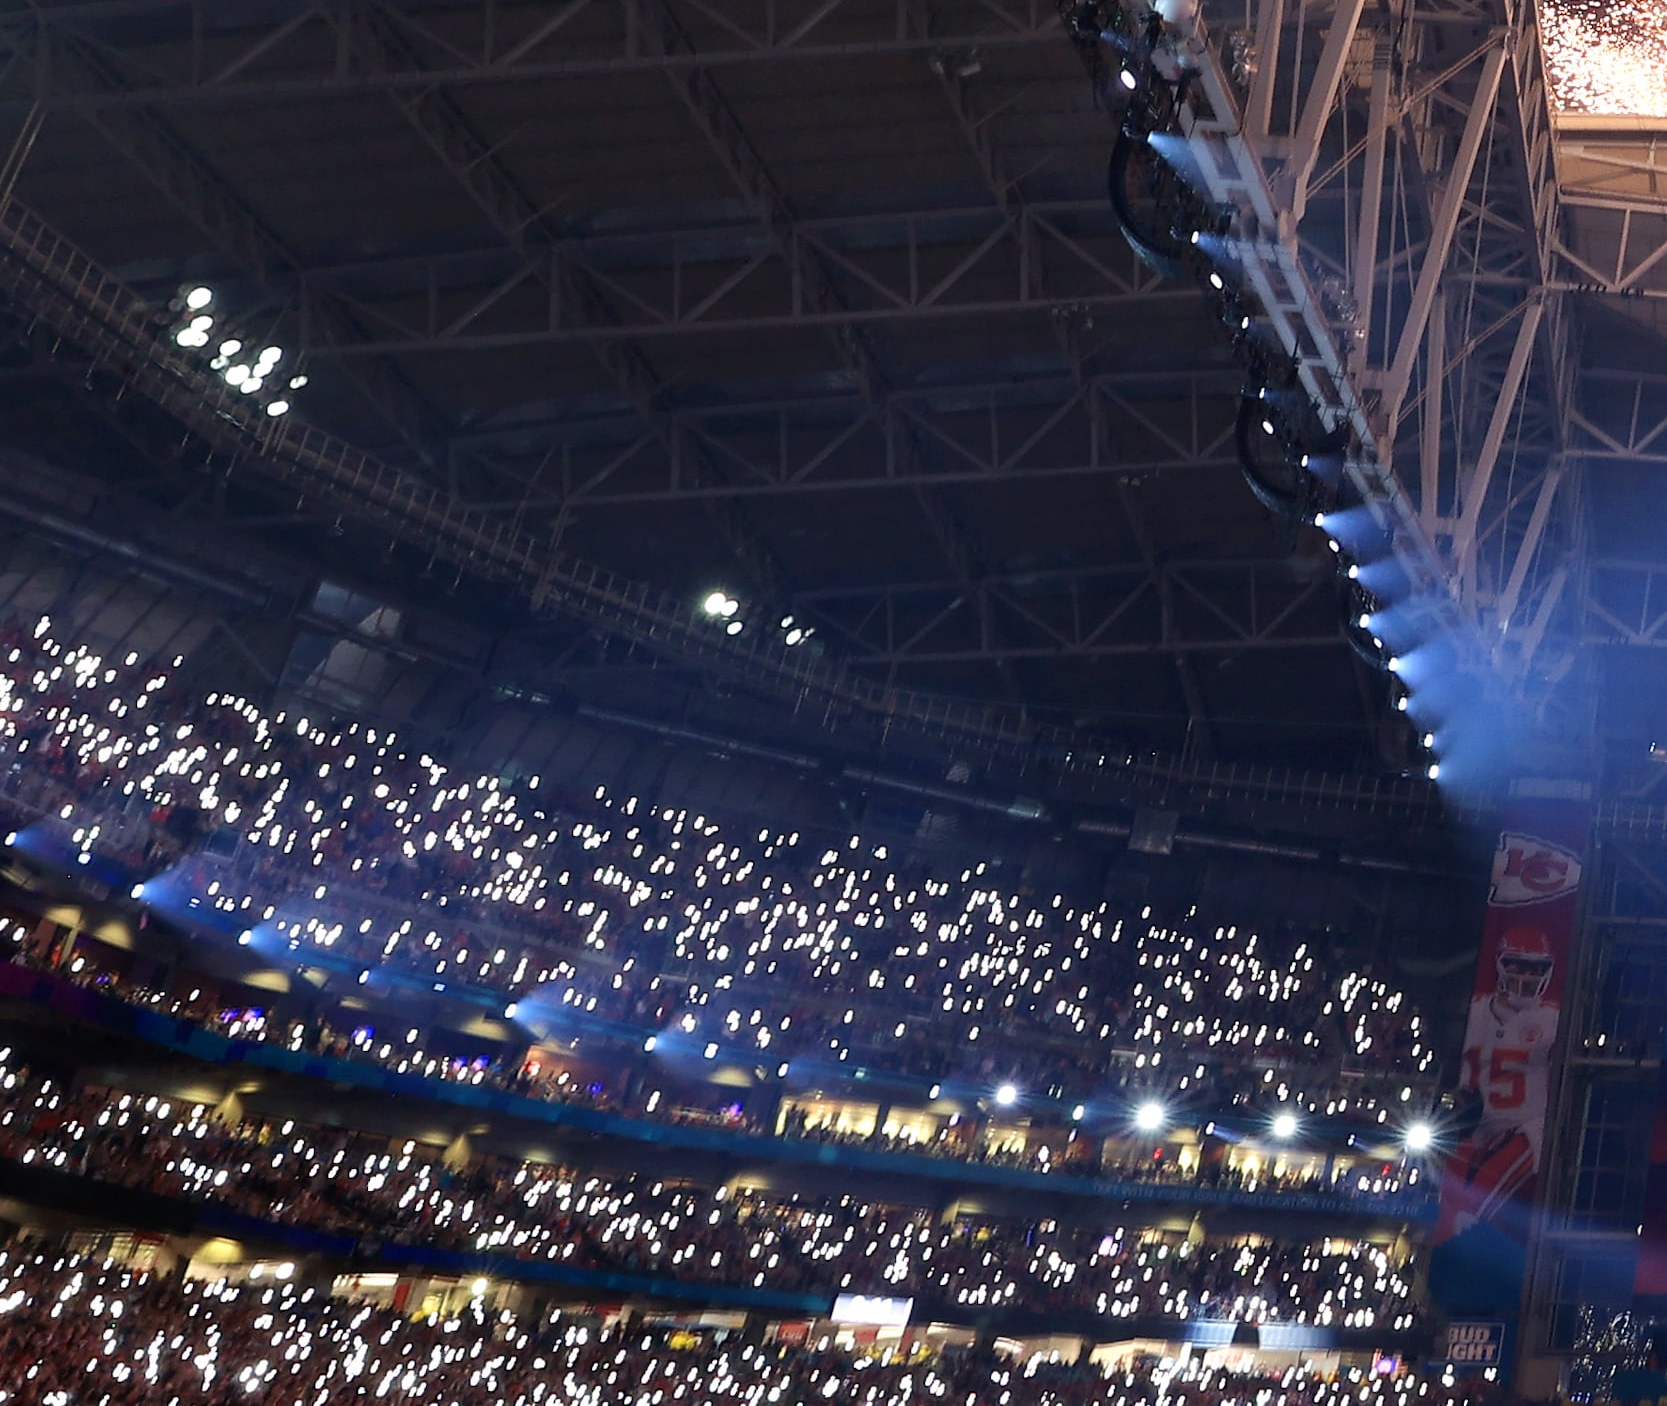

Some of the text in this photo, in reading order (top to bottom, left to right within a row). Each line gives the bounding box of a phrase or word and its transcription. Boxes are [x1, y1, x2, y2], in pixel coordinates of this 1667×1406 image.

[1464, 1047, 1530, 1110] 15
[1448, 1327, 1490, 1344] BUD
[1446, 1343, 1497, 1361] IGHT
